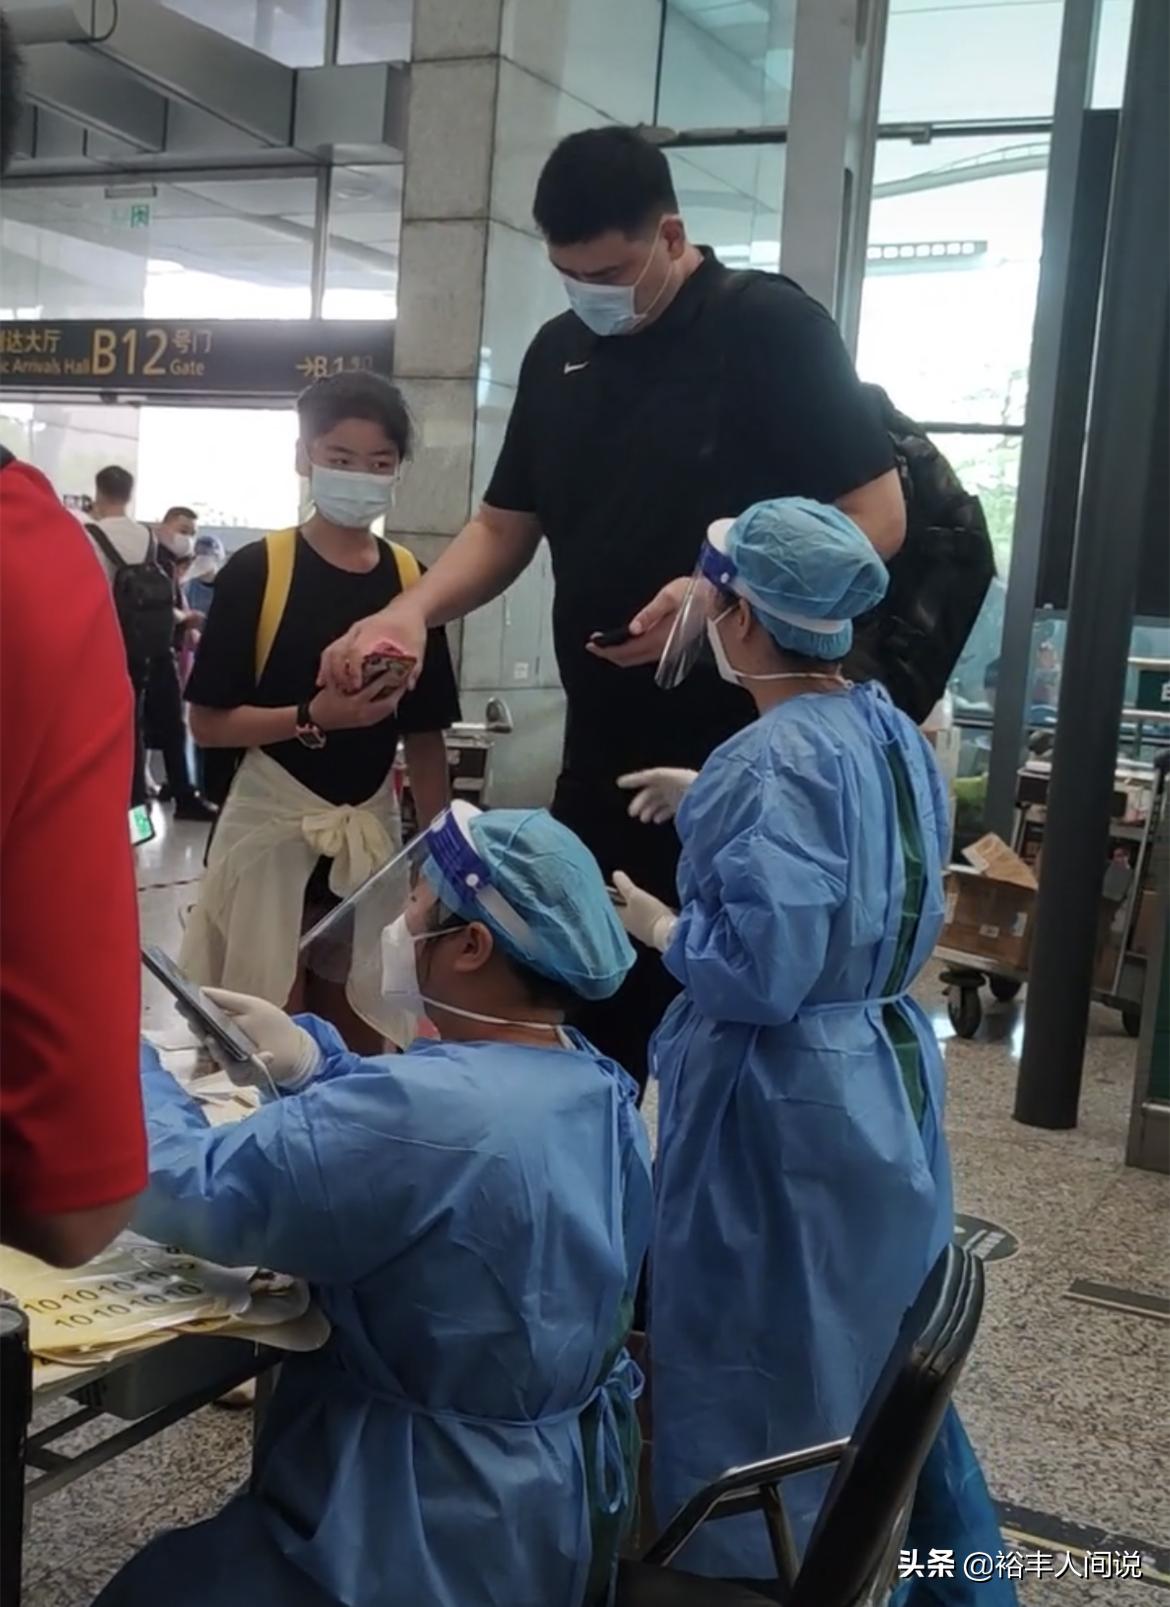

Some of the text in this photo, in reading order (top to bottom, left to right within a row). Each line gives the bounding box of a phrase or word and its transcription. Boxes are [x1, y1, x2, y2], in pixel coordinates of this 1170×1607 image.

[92, 328, 167, 375] B12
[172, 329, 212, 354] 号门
[169, 359, 205, 376] Gate
